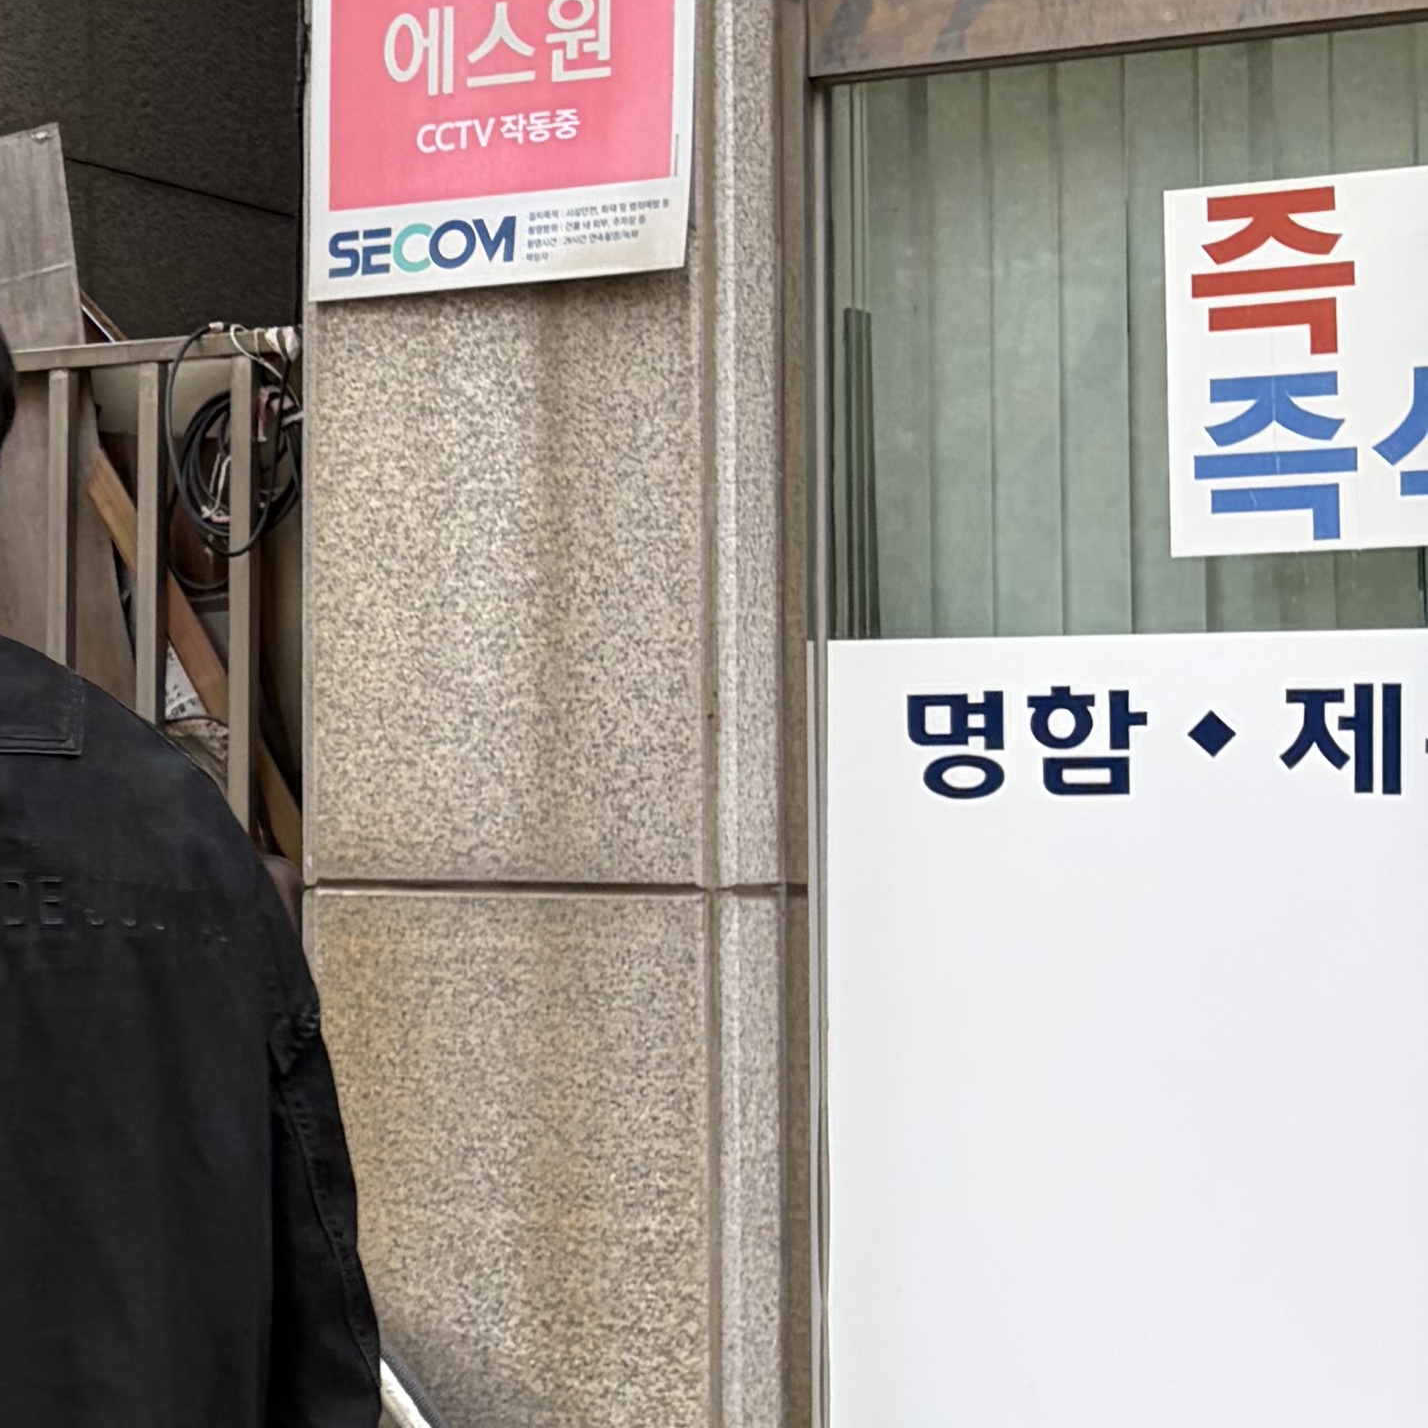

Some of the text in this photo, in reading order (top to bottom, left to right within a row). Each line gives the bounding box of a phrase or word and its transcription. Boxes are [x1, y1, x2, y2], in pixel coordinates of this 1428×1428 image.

[416, 109, 579, 154] CCTV 작동중
[328, 216, 516, 279] SECOM
[1191, 186, 1356, 355] 즉
[907, 683, 1428, 799] 명함 제
